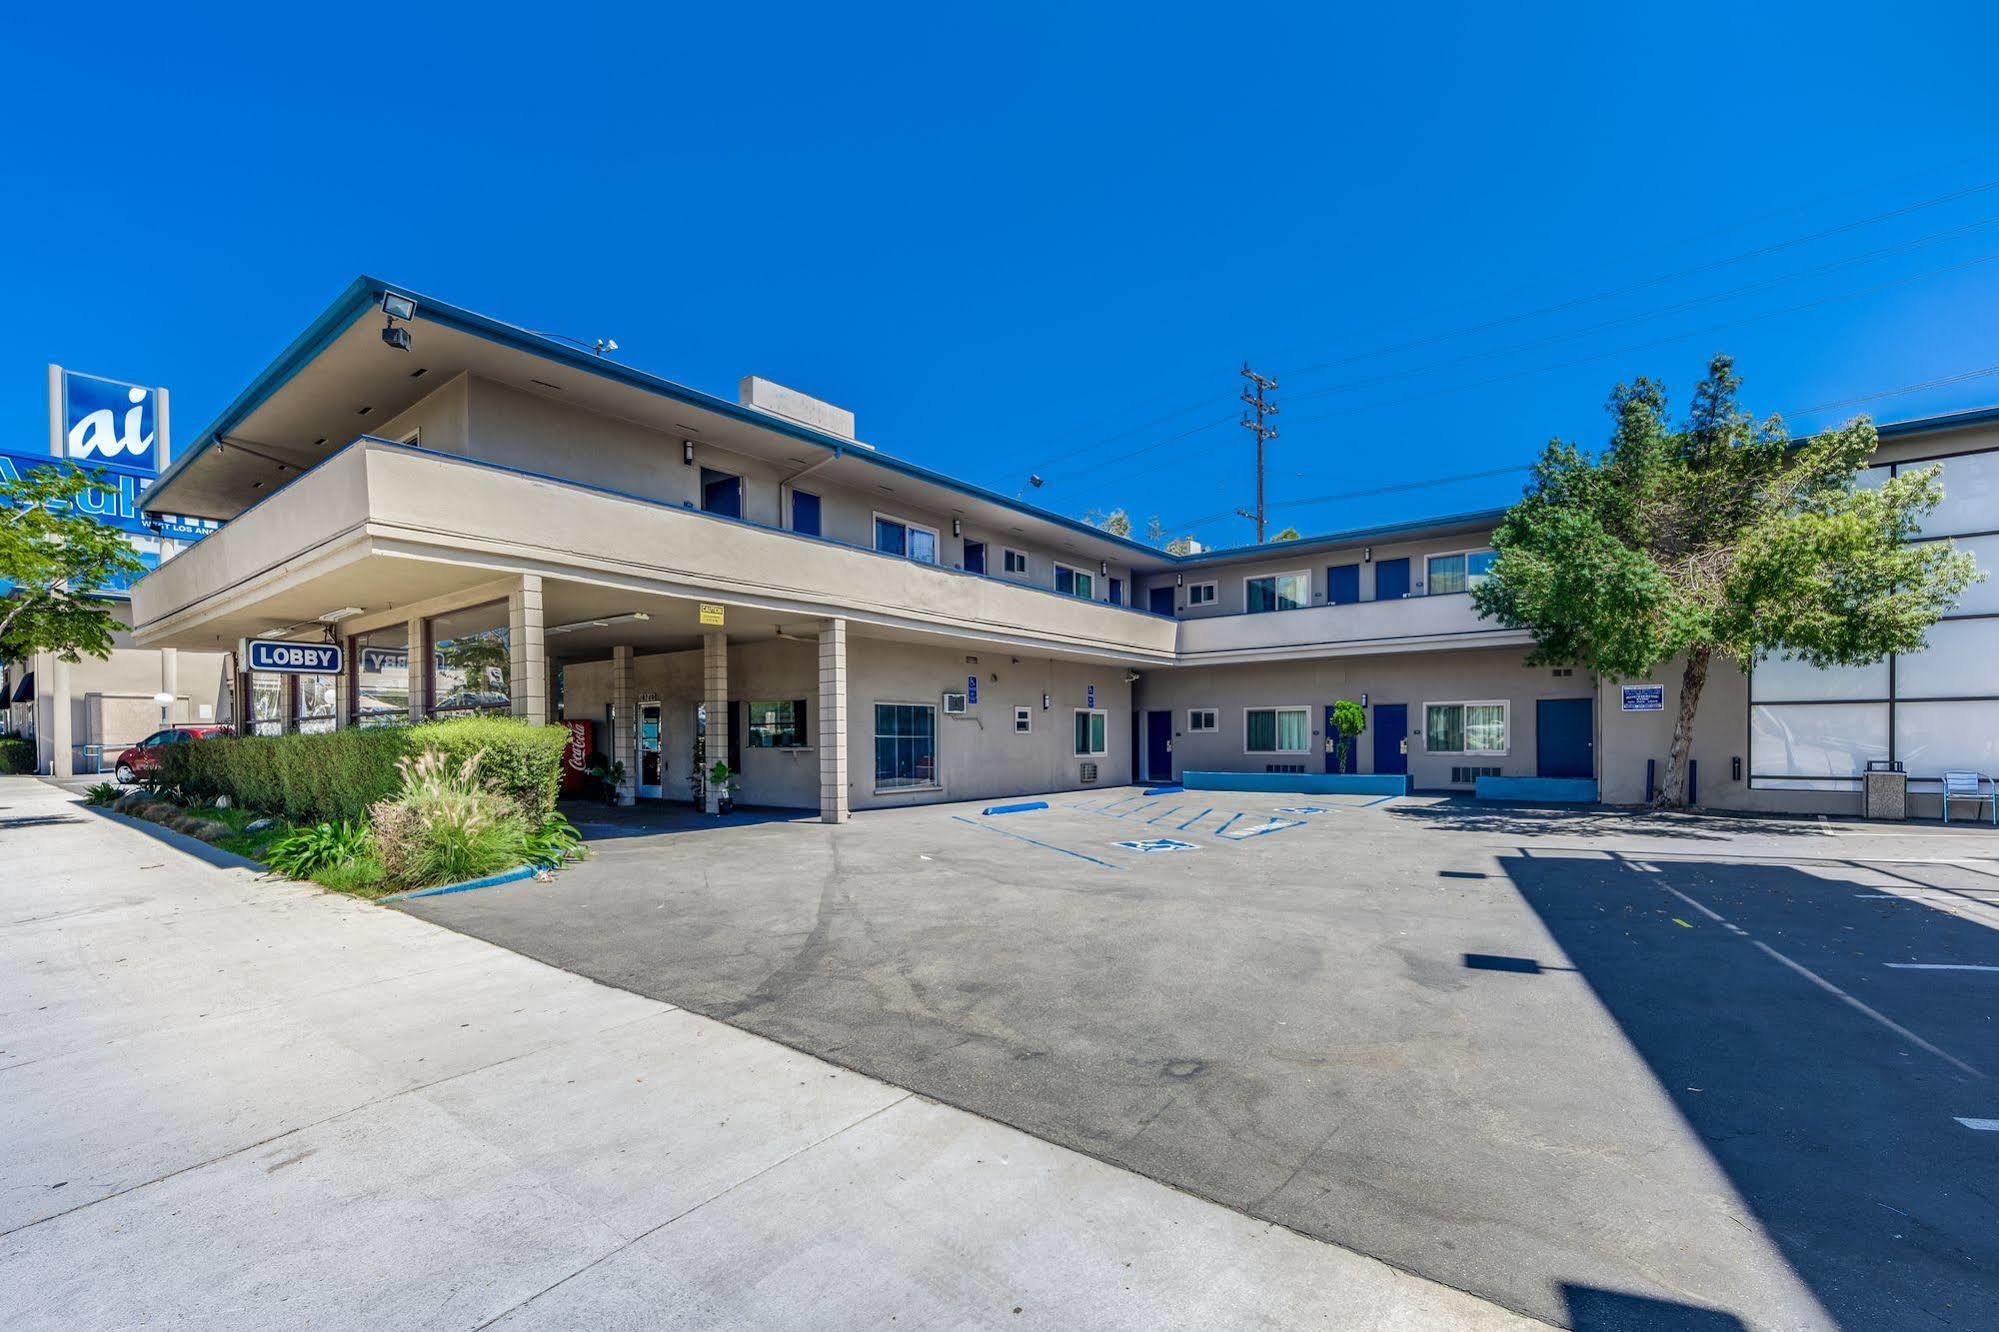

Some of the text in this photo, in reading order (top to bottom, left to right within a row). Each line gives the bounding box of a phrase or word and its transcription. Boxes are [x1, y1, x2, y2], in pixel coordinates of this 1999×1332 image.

[69, 388, 153, 458] ai
[0, 456, 134, 519] ul
[142, 520, 170, 531] WST
[173, 525, 192, 533] LOS
[260, 647, 332, 667] LOBBY
